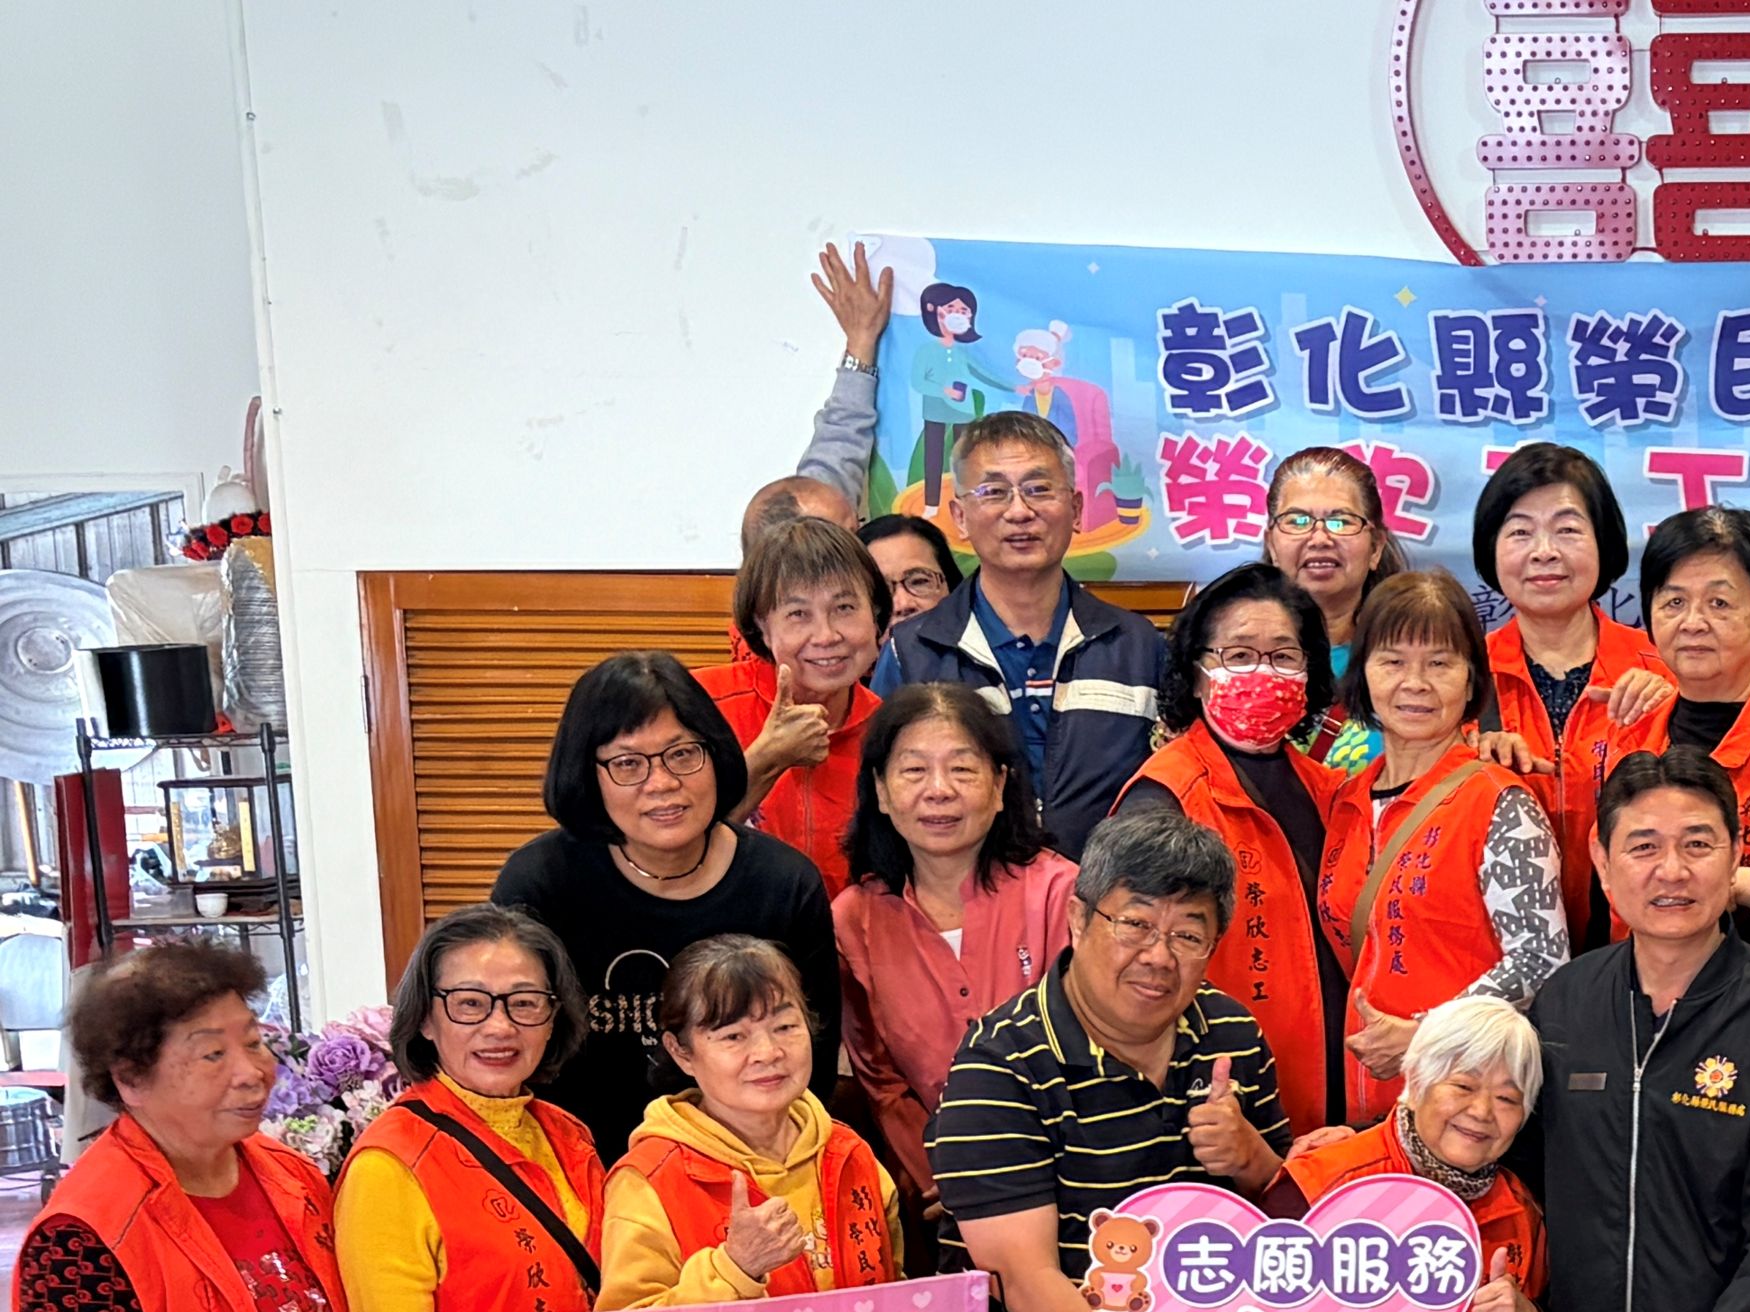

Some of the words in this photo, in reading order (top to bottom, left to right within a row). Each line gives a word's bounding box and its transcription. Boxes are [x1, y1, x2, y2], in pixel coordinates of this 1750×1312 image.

[1245, 881, 1270, 1001] 榮欣志工
[849, 1222, 876, 1286] 榮民
[1176, 1235, 1469, 1295] 志願服務
